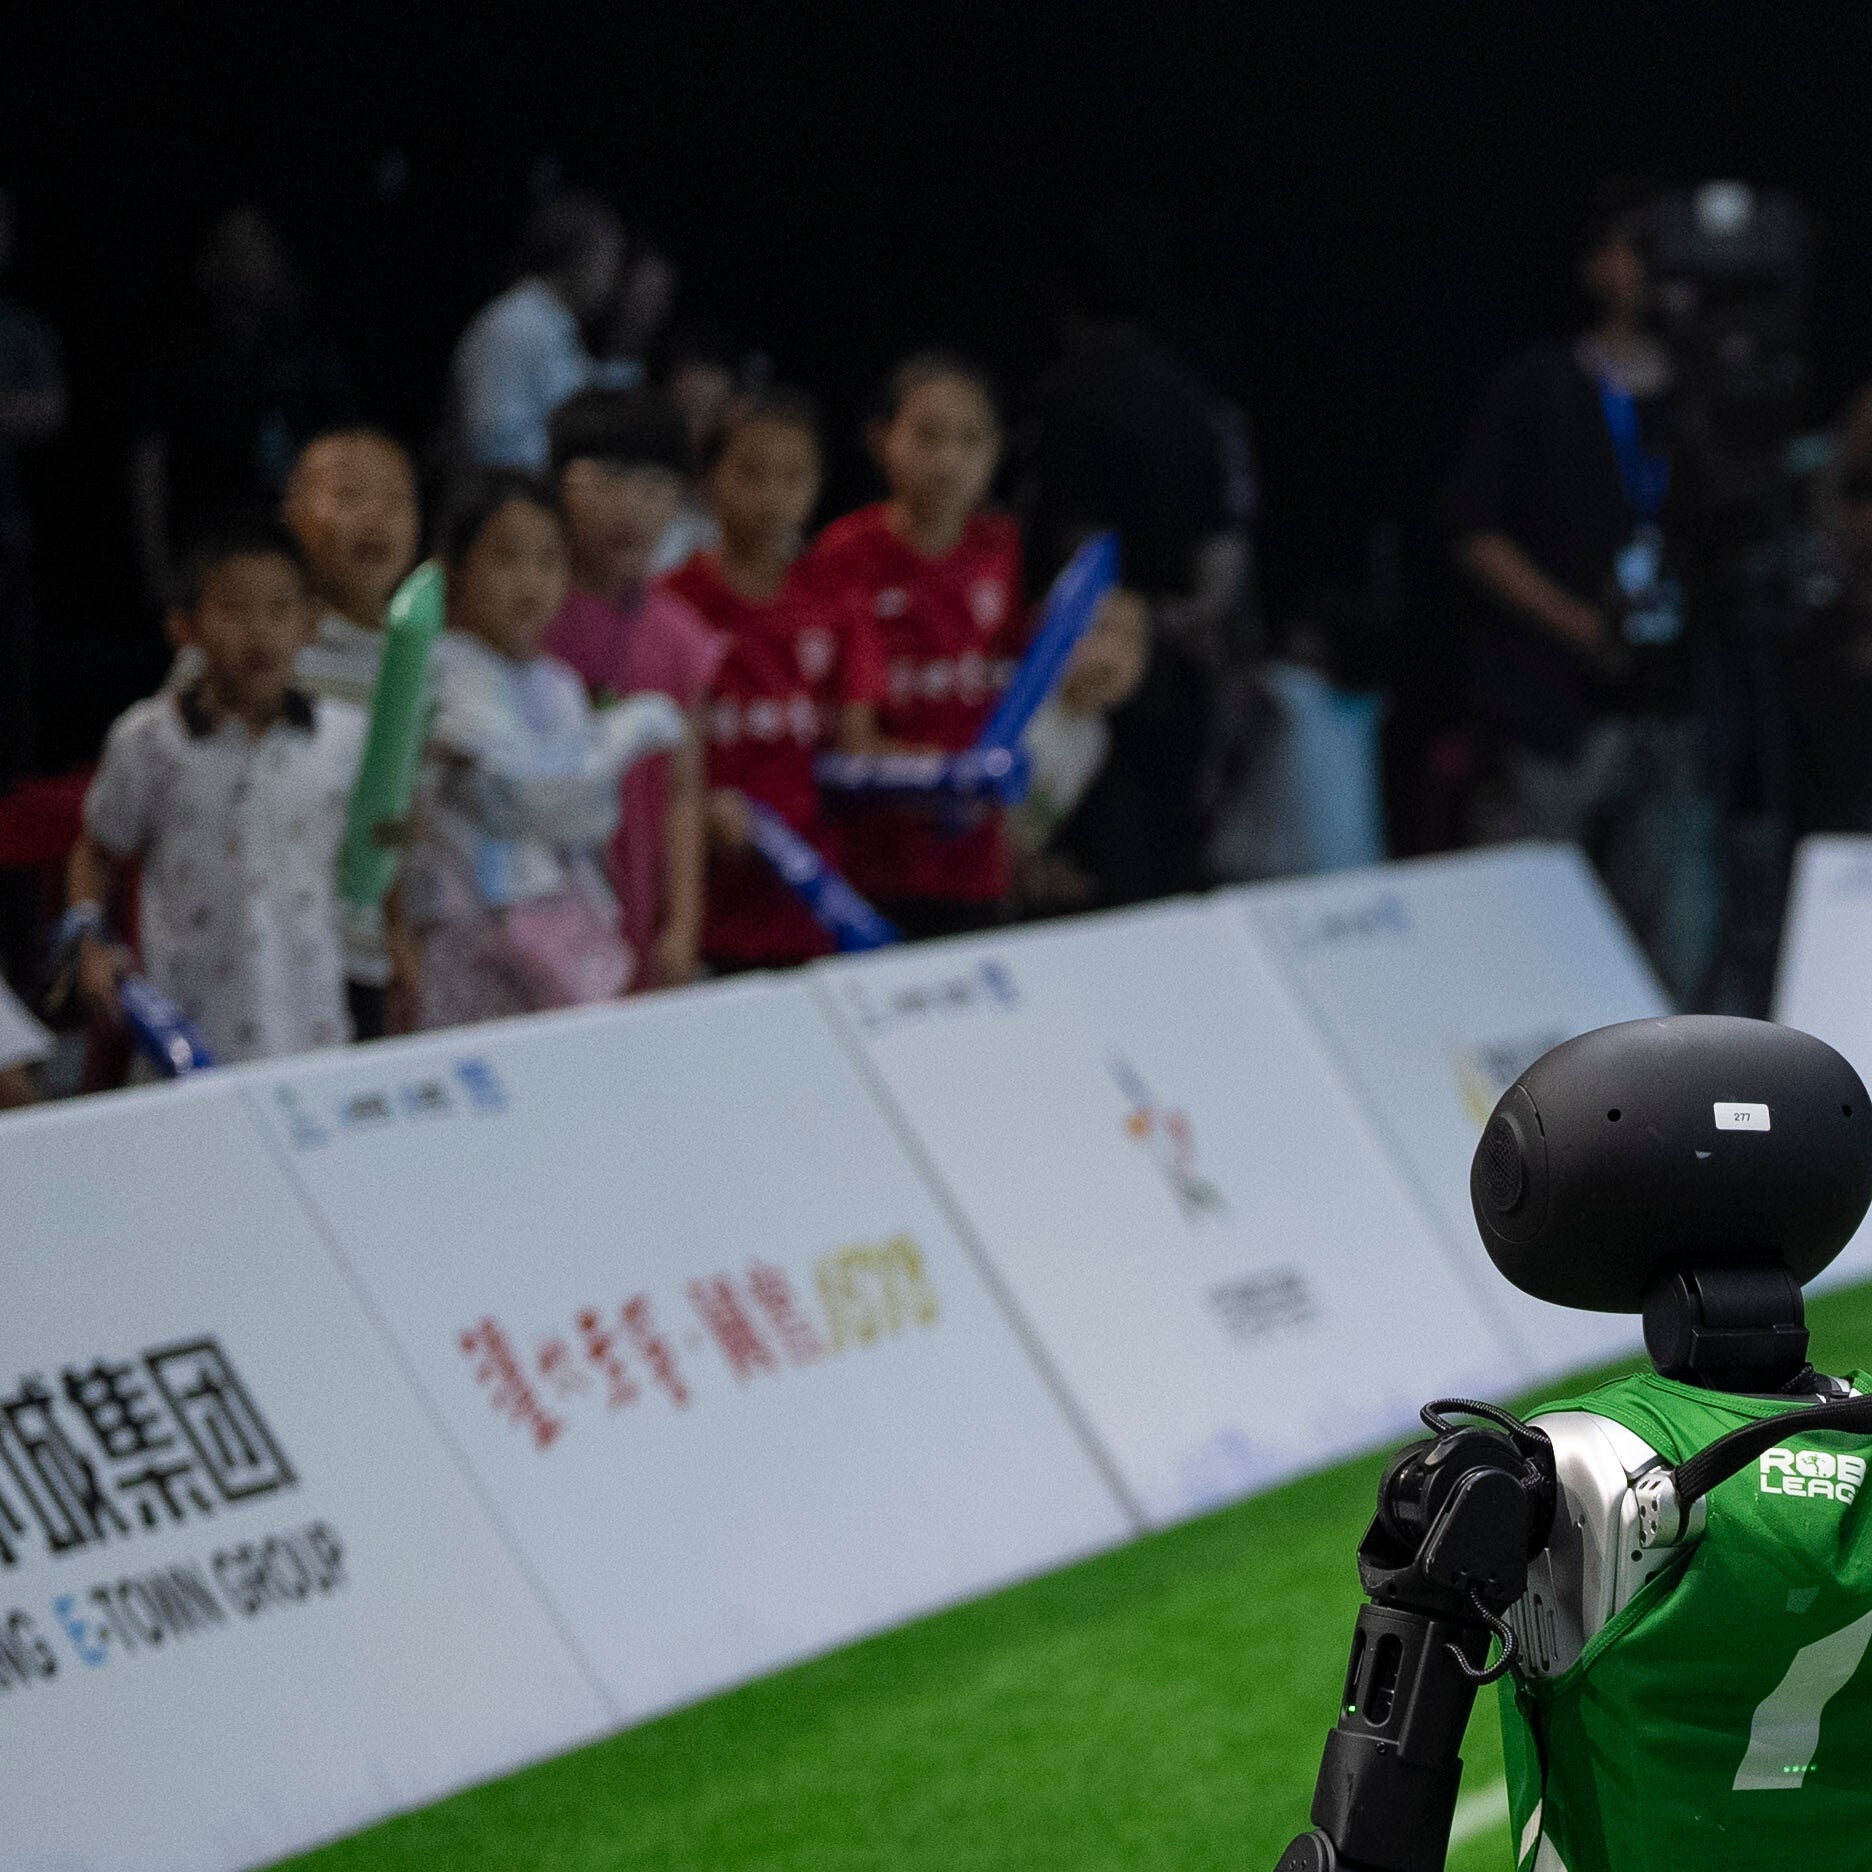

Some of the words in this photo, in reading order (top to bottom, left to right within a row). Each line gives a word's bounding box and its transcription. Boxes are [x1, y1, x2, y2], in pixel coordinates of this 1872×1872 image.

[1733, 1112, 1751, 1121] 277
[1760, 1447, 1866, 1487] ROB
[1760, 1474, 1855, 1506] LEAG
